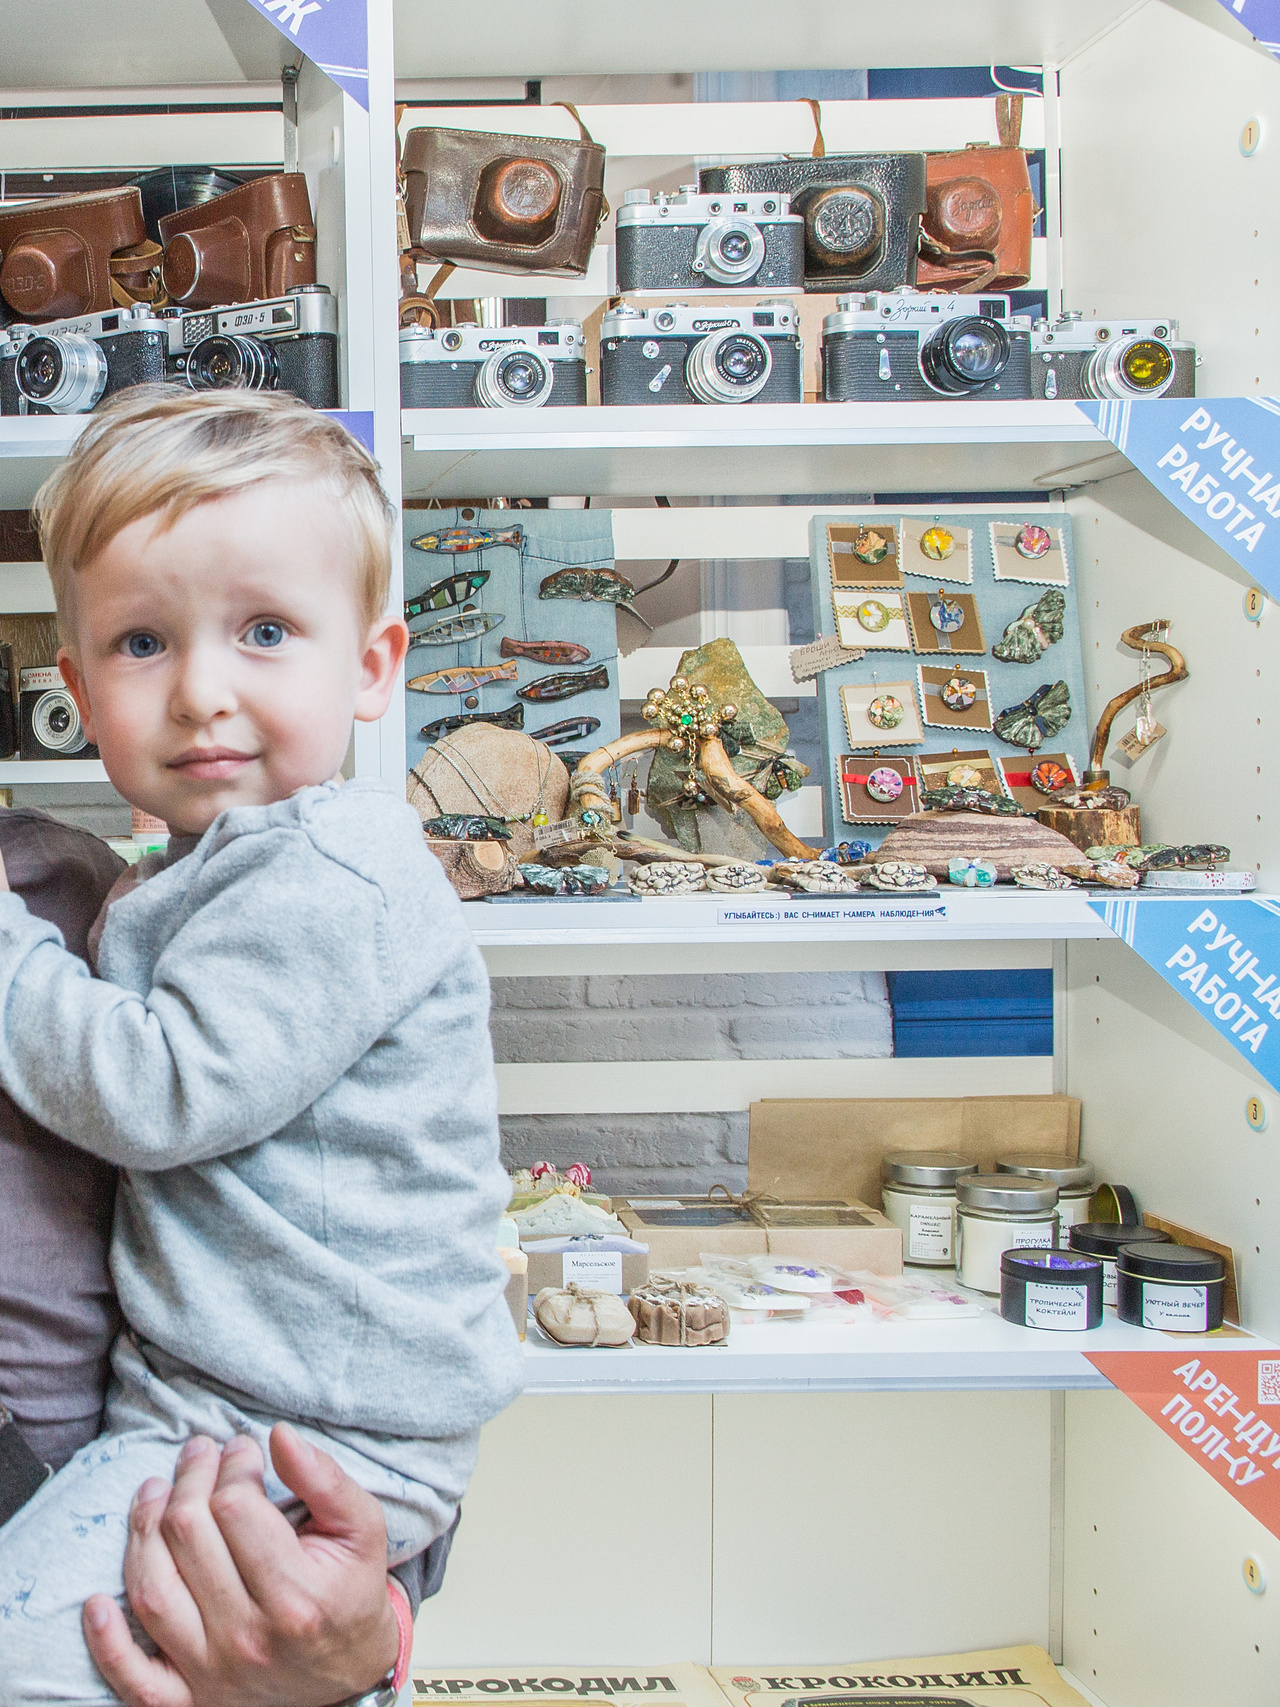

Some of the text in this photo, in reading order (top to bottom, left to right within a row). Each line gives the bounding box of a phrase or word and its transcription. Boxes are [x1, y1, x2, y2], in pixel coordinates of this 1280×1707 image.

[1179, 406, 1280, 519] РУЧНА
[1156, 443, 1266, 553] РАБОТА
[784, 911, 799, 919] ВАС
[801, 911, 841, 919] СНИМАЕТ
[880, 910, 935, 918] НАБЛЮДЕНИЯ
[1186, 908, 1280, 1020] РУЧНА
[1165, 943, 1269, 1054] РАБОТА
[571, 1260, 616, 1268] Марсельское
[1030, 1298, 1082, 1307] ТРОПИЧЕСКИЕ
[1036, 1307, 1077, 1316] КОКТЕЙЛИ
[1145, 1298, 1180, 1308] УЮТНЫЙ
[1172, 1358, 1280, 1470] АРЕНДУ
[1160, 1393, 1266, 1486] ПОЛКУ
[412, 1676, 679, 1696] КРОКОДИЛ
[760, 1668, 1032, 1690] КРОКОДИЛ
